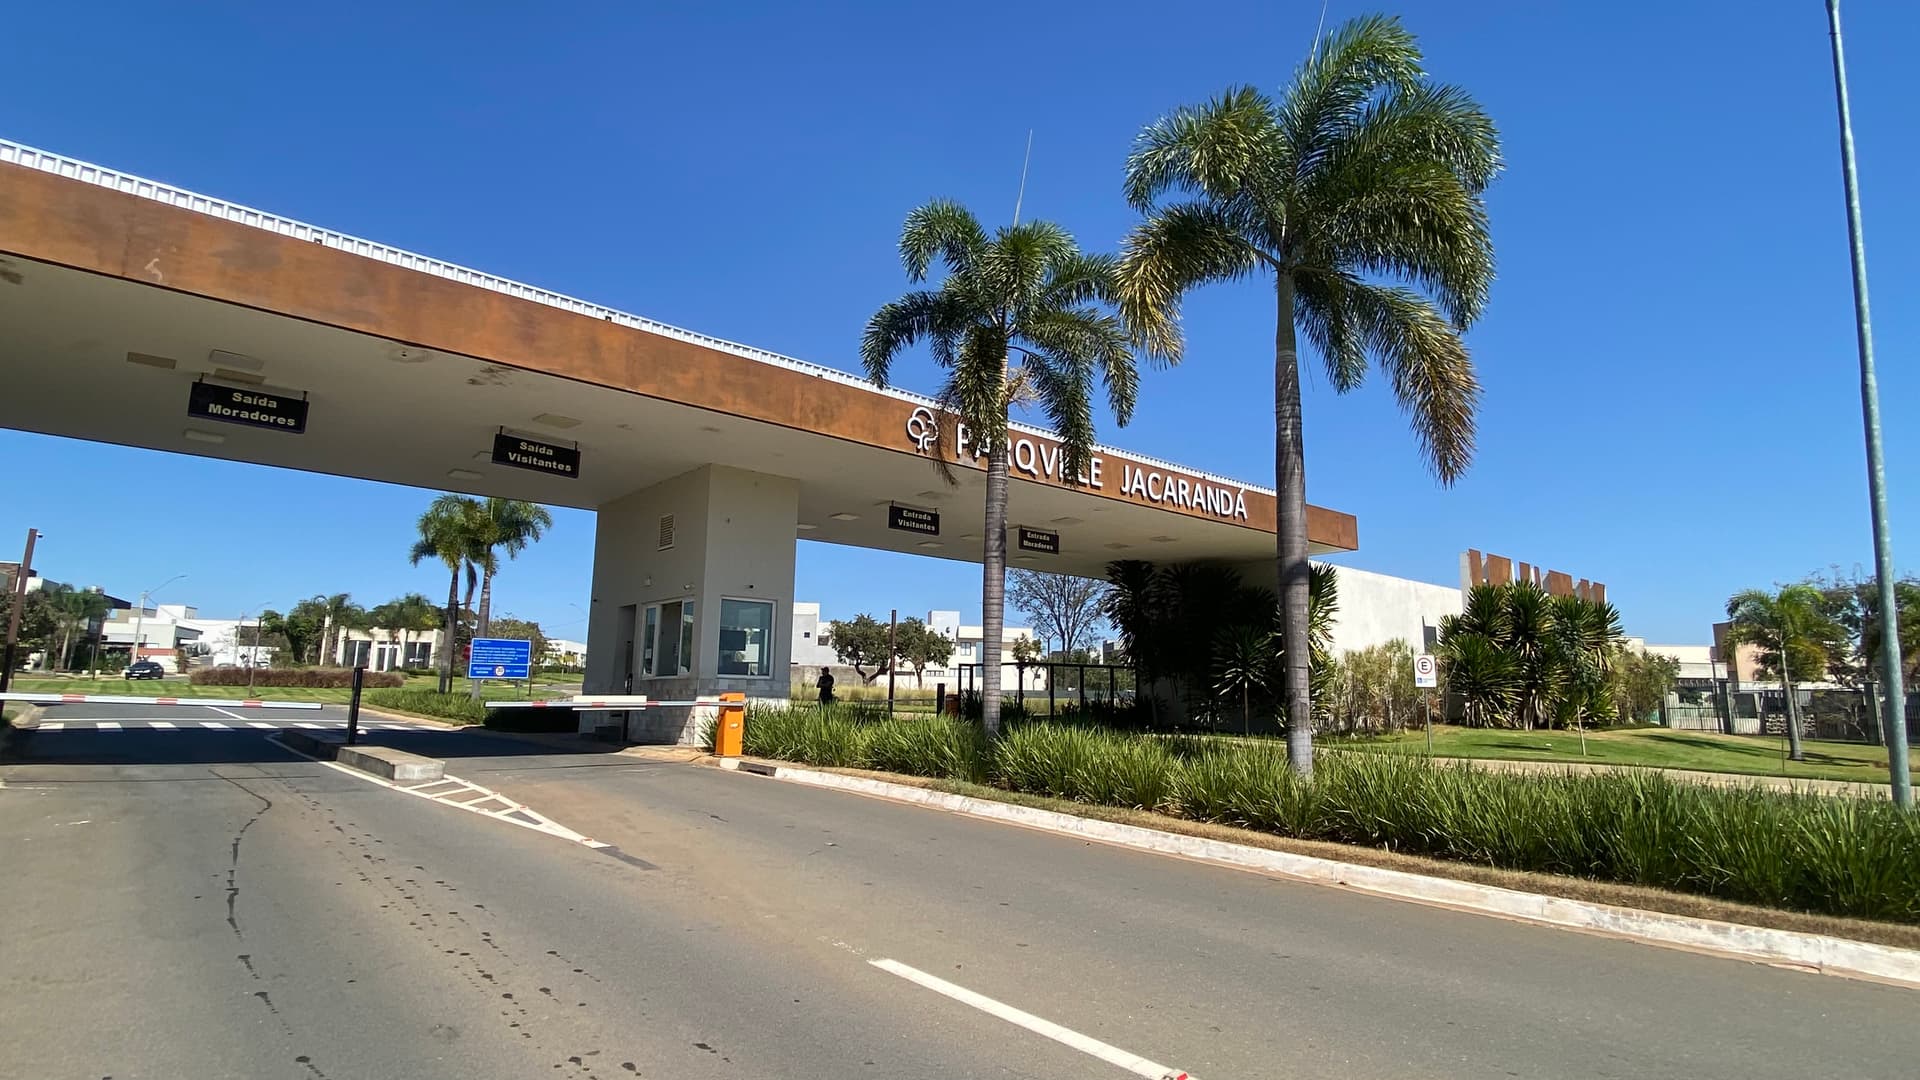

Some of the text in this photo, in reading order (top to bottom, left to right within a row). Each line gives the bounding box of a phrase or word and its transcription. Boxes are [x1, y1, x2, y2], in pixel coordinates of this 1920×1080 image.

[231, 392, 278, 408] Saída
[208, 403, 296, 426] Moradores
[519, 441, 554, 456] Saída
[507, 451, 572, 472] Visitantes
[1121, 464, 1248, 519] JACARANDÁ
[902, 510, 932, 521] Entrada
[897, 518, 936, 532] Visitantes
[1421, 661, 1428, 670] E
